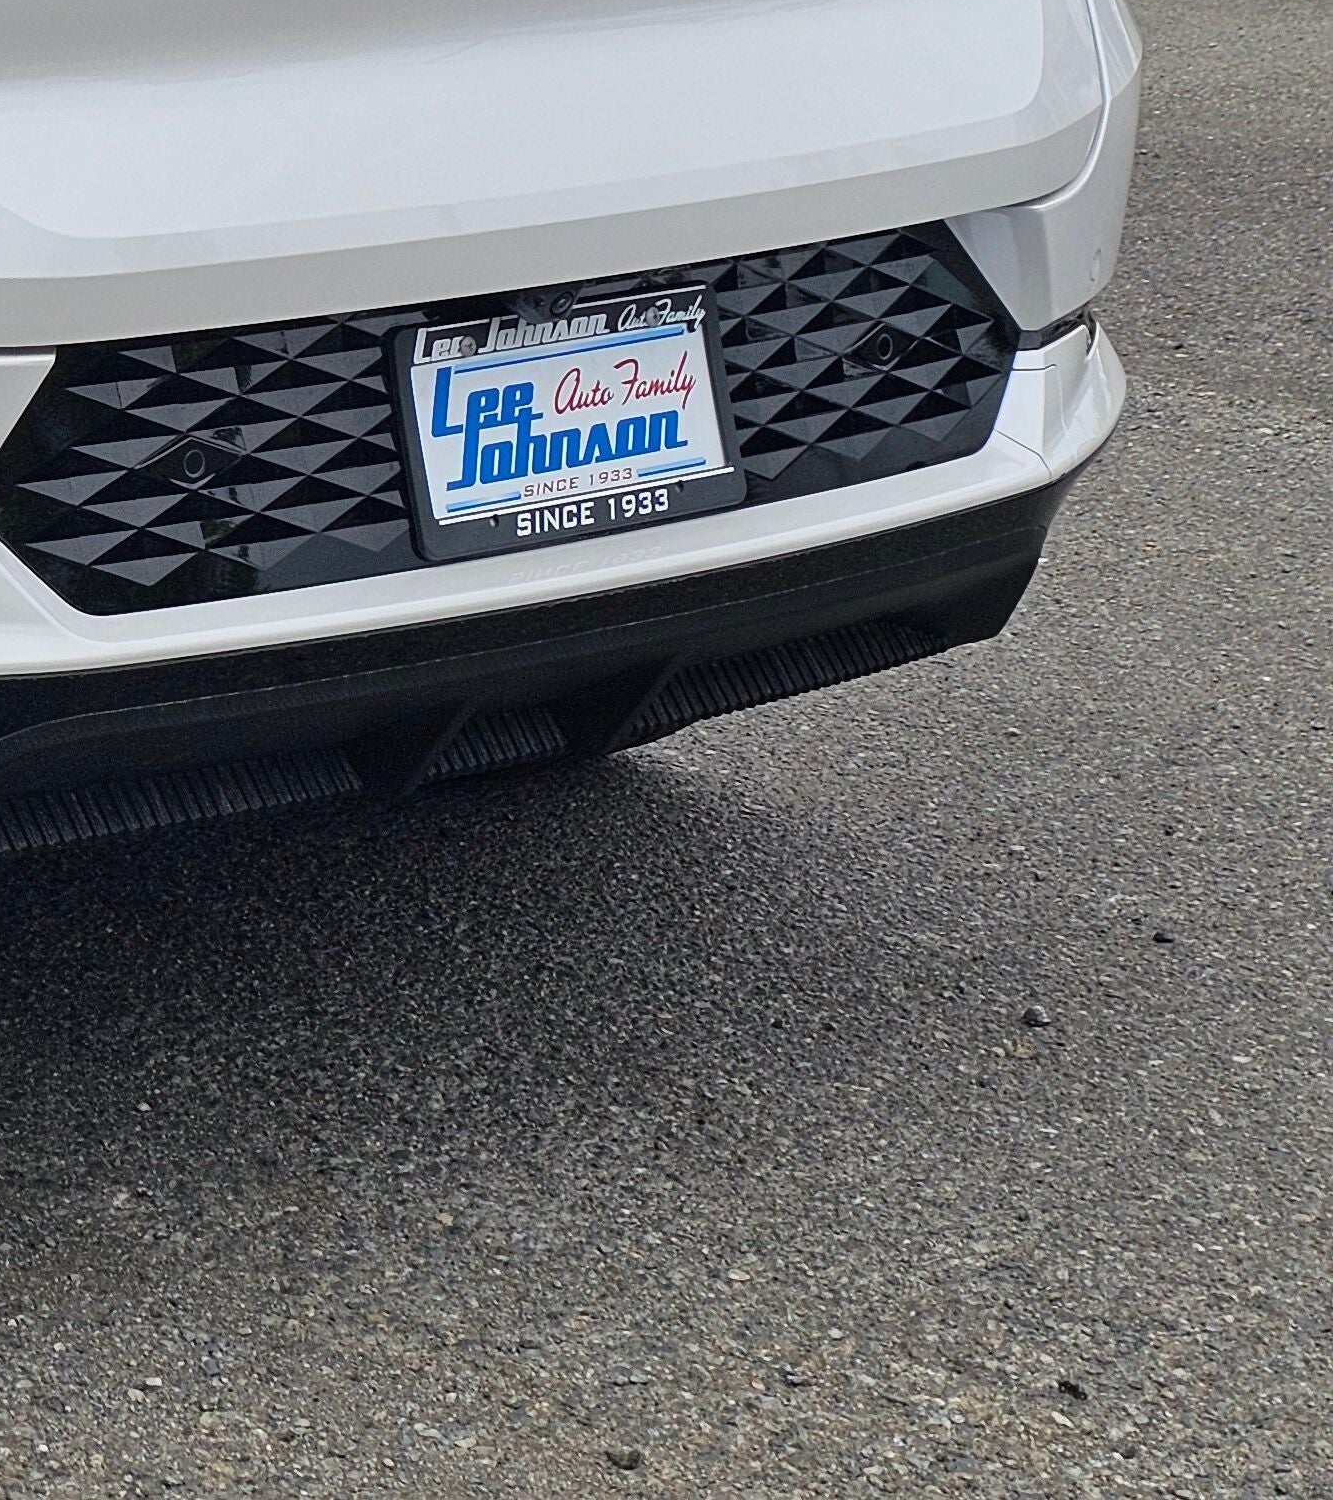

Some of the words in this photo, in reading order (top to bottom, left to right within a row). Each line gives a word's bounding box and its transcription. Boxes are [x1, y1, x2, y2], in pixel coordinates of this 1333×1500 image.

[478, 313, 610, 354] Johnson
[653, 294, 707, 330] Family
[431, 366, 544, 437] Lee
[554, 367, 614, 414] Auto
[613, 350, 697, 409] Family
[446, 409, 689, 492] Johnson
[516, 500, 596, 537] SINCE
[607, 488, 669, 519] 1933
[523, 478, 579, 498] SINCE
[589, 467, 633, 486] 1933
